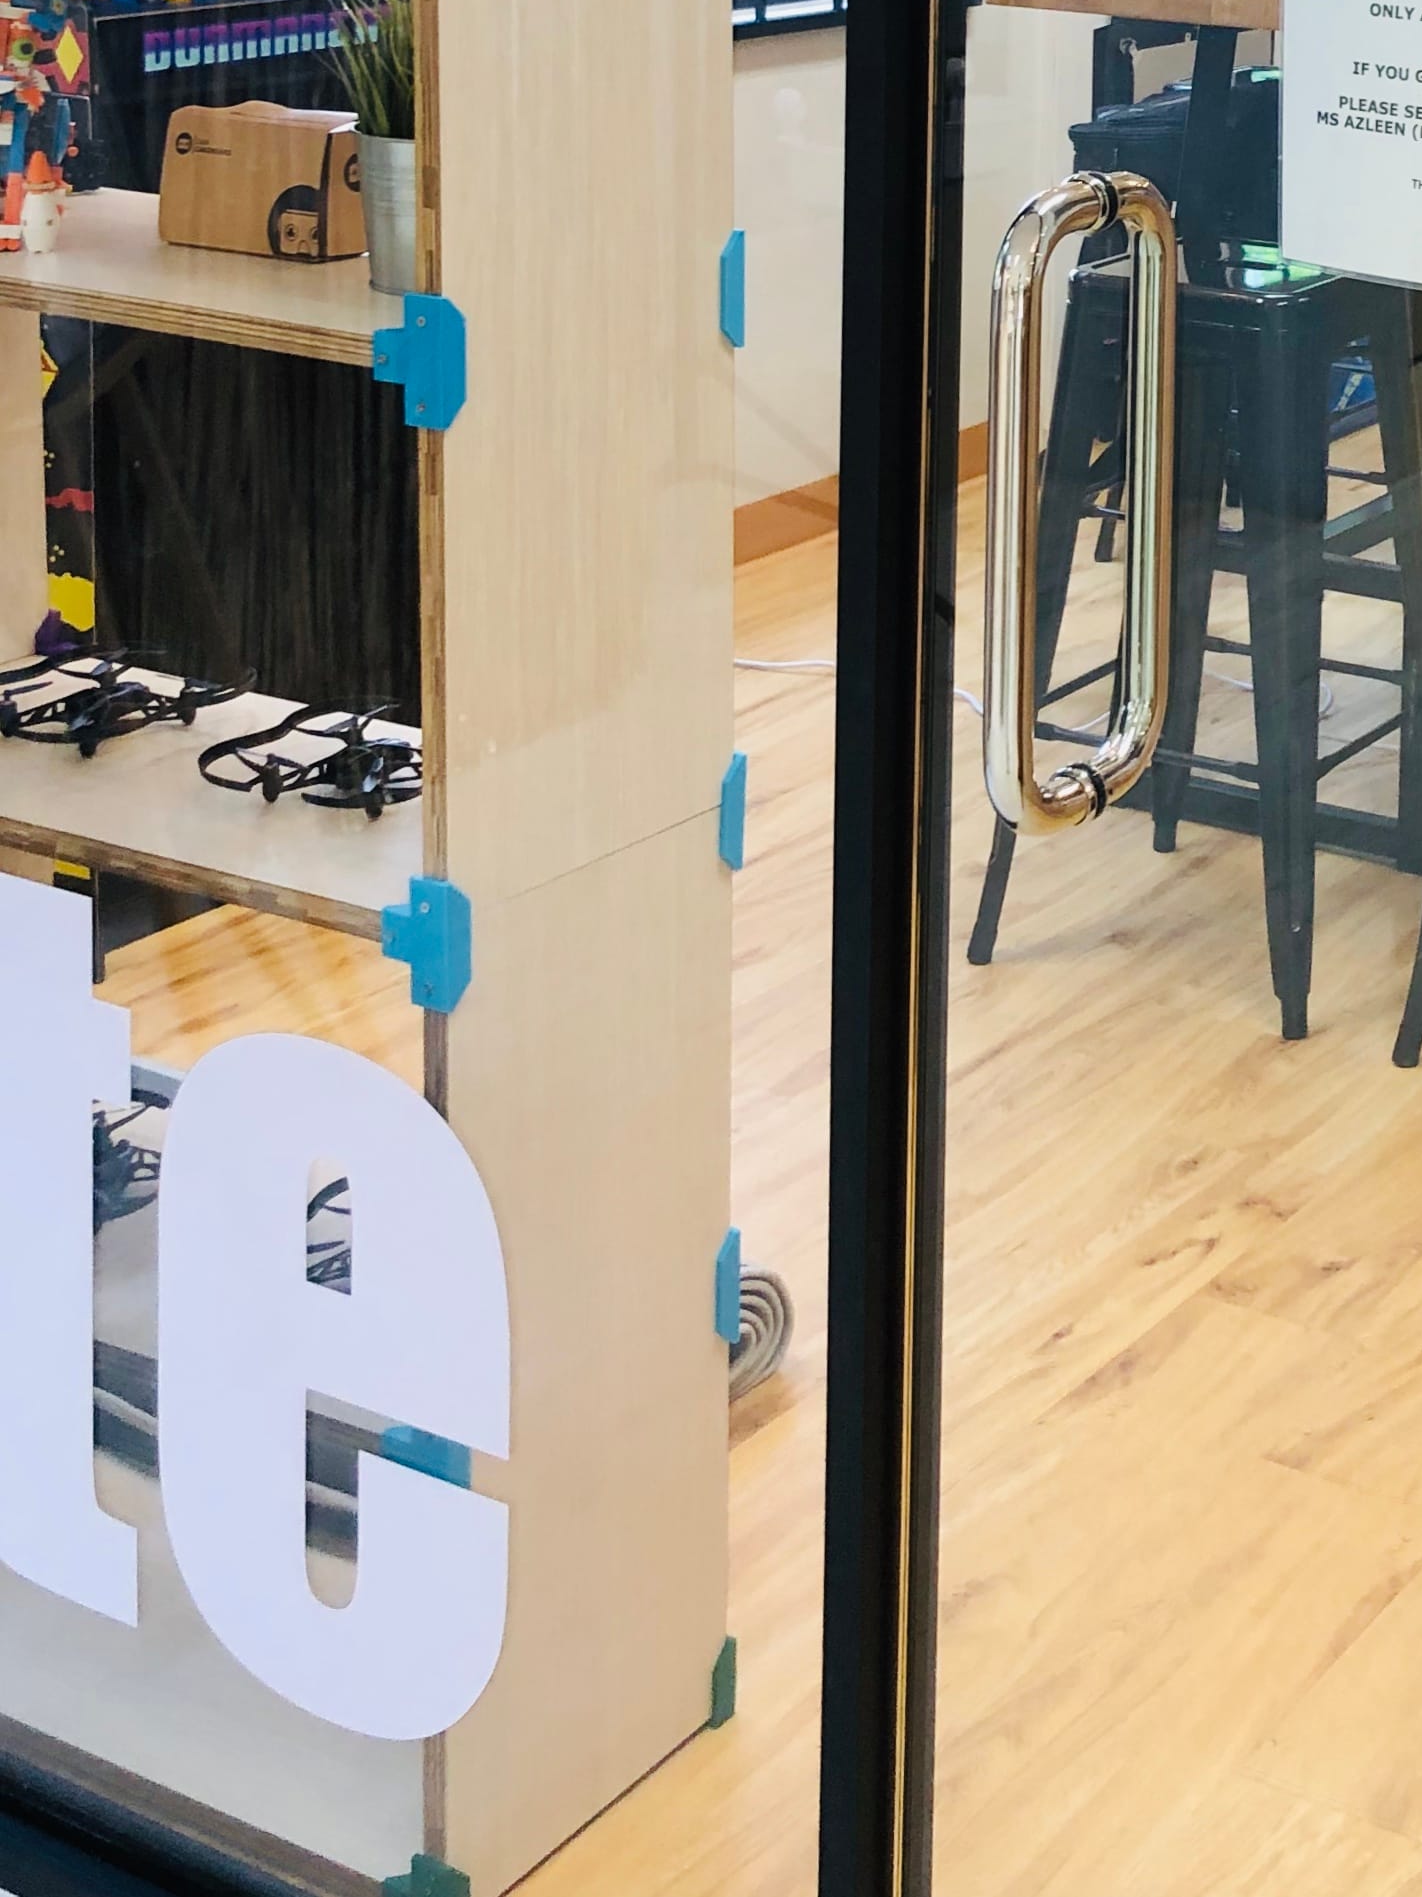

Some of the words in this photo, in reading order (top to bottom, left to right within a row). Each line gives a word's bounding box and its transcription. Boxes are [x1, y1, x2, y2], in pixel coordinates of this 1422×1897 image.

[1369, 2, 1415, 21] ONLY
[1352, 61, 1370, 76] IF
[1375, 63, 1410, 81] YOU
[1338, 95, 1399, 117] PLEASE
[1316, 111, 1339, 127] MS
[1343, 116, 1407, 137] AZLEEN
